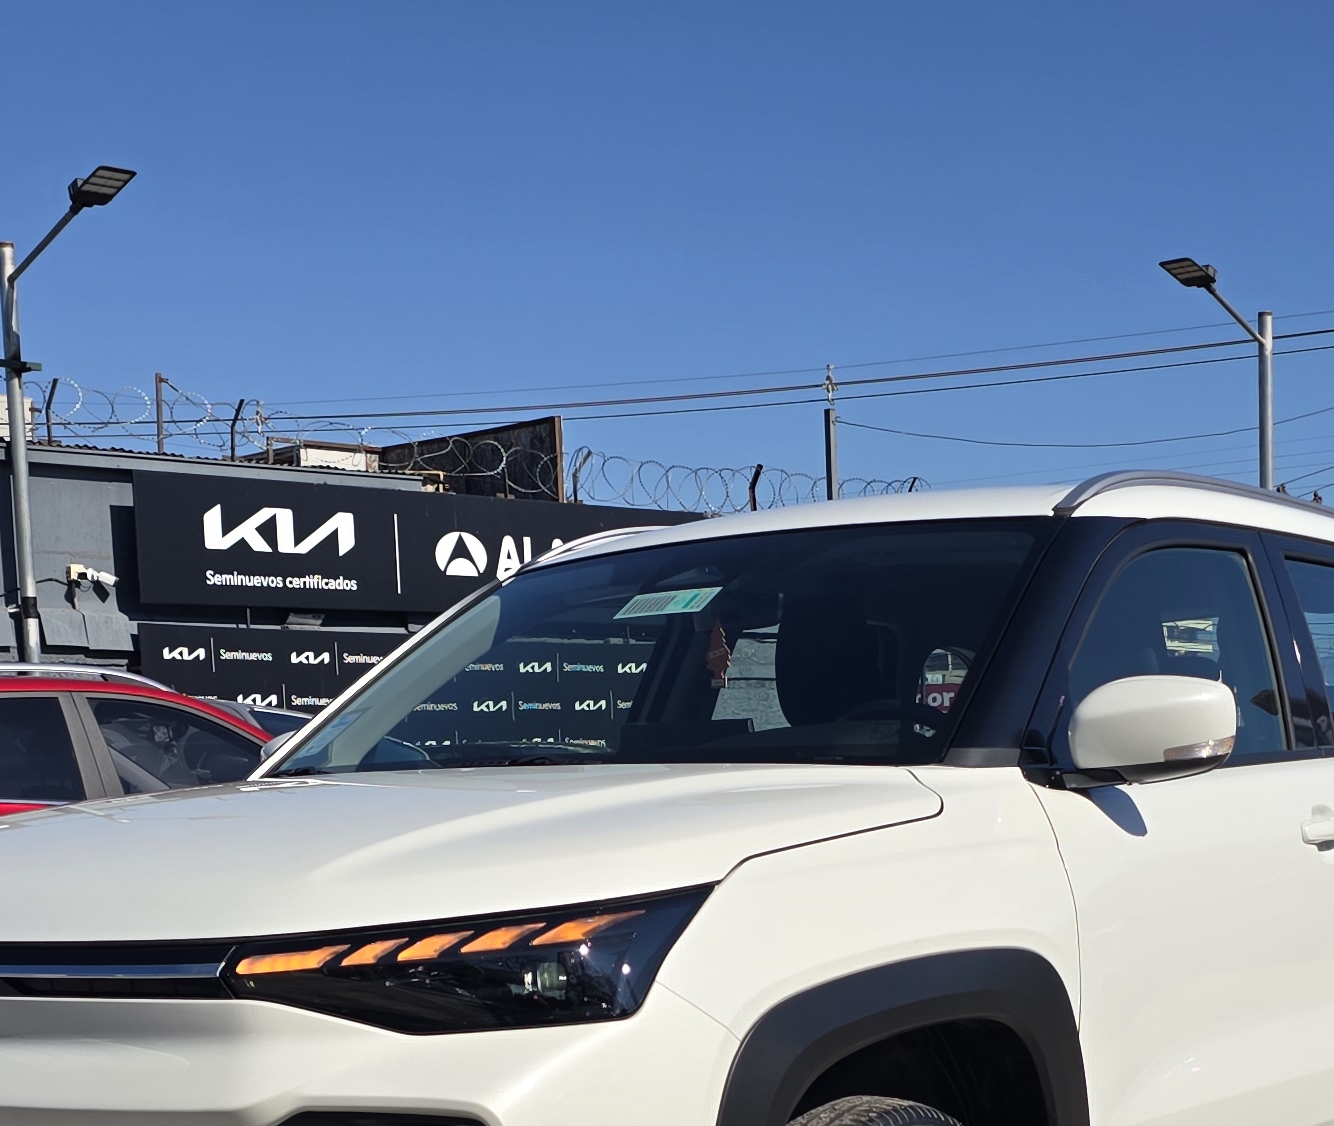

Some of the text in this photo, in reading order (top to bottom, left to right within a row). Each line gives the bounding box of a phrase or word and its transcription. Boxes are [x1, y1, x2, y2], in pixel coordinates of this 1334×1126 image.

[202, 503, 356, 557] KIA
[205, 569, 359, 591] Seminuevos certificados
[162, 646, 384, 665] KIA Seminuevos KIA Seminuev
[562, 662, 605, 673] Seminuevos
[290, 694, 334, 706] Seminuev
[518, 700, 562, 711] Seminuevos
